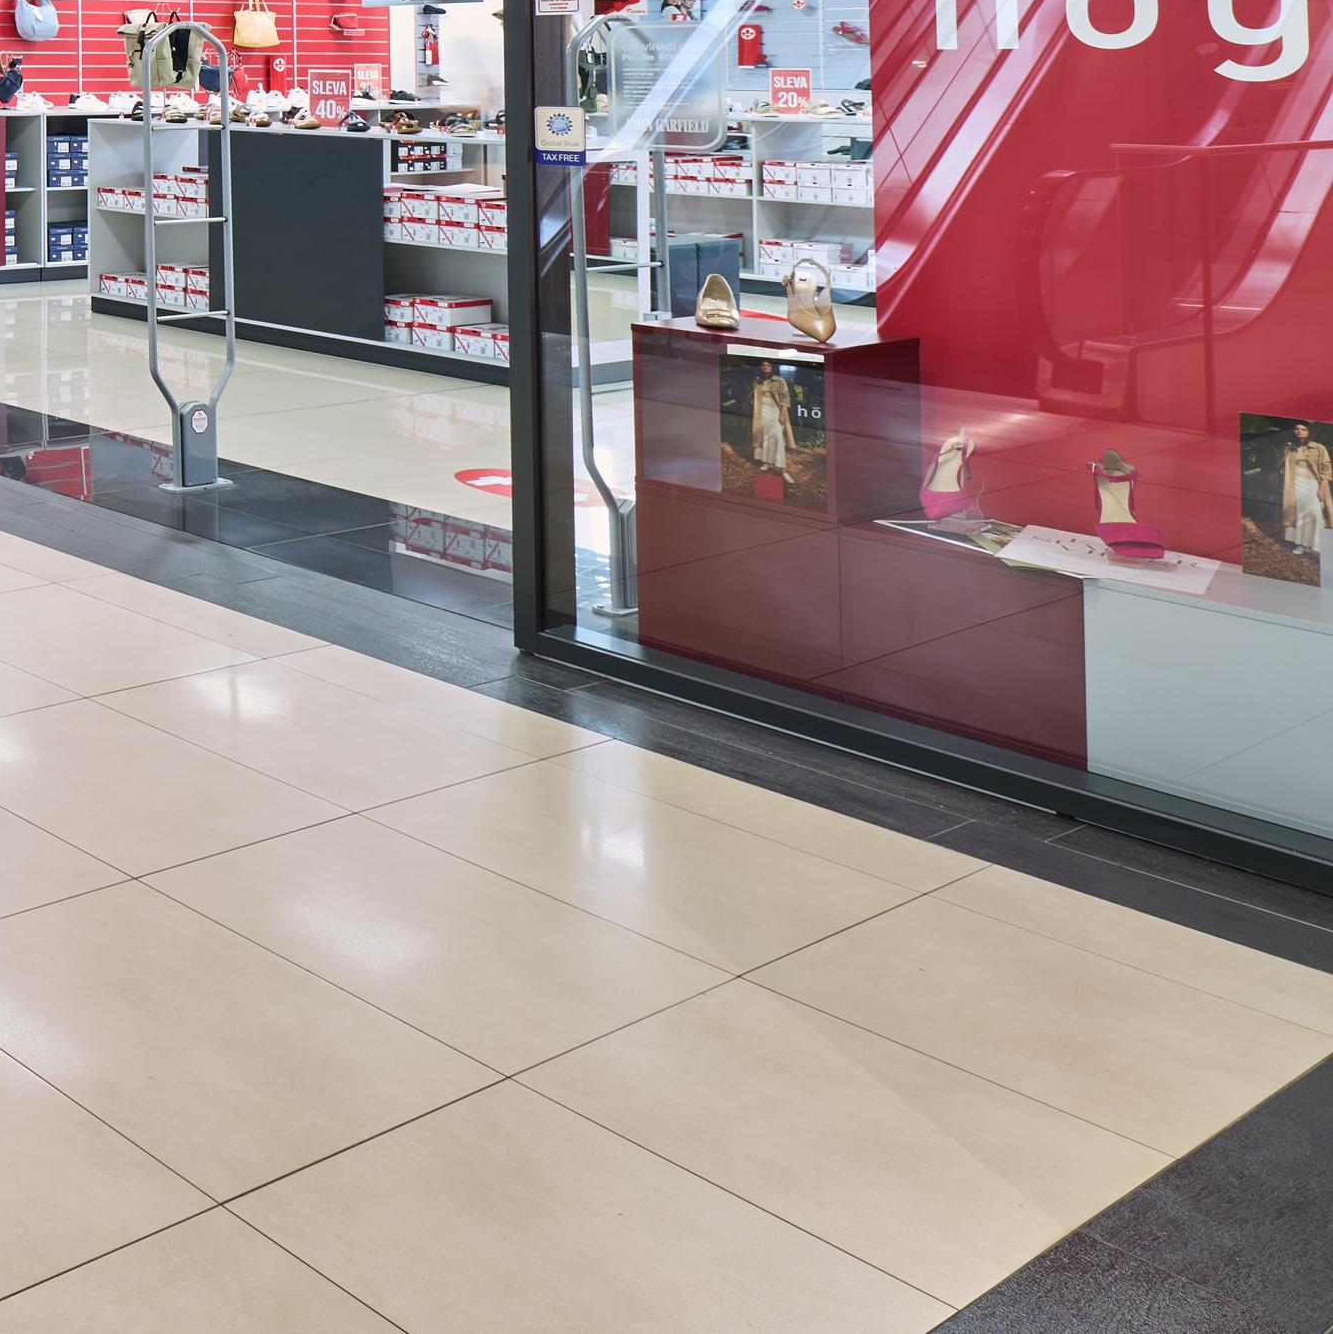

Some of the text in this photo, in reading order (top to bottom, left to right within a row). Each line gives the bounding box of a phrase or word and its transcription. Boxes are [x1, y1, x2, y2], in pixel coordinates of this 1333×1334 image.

[357, 70, 379, 80] SLEVA
[773, 76, 808, 88] SLEVA
[313, 80, 347, 95] SLEVA
[777, 91, 806, 108] 20%
[315, 99, 346, 119] 40%
[656, 119, 709, 133] GARFIELD
[542, 153, 580, 162] TAX FREE
